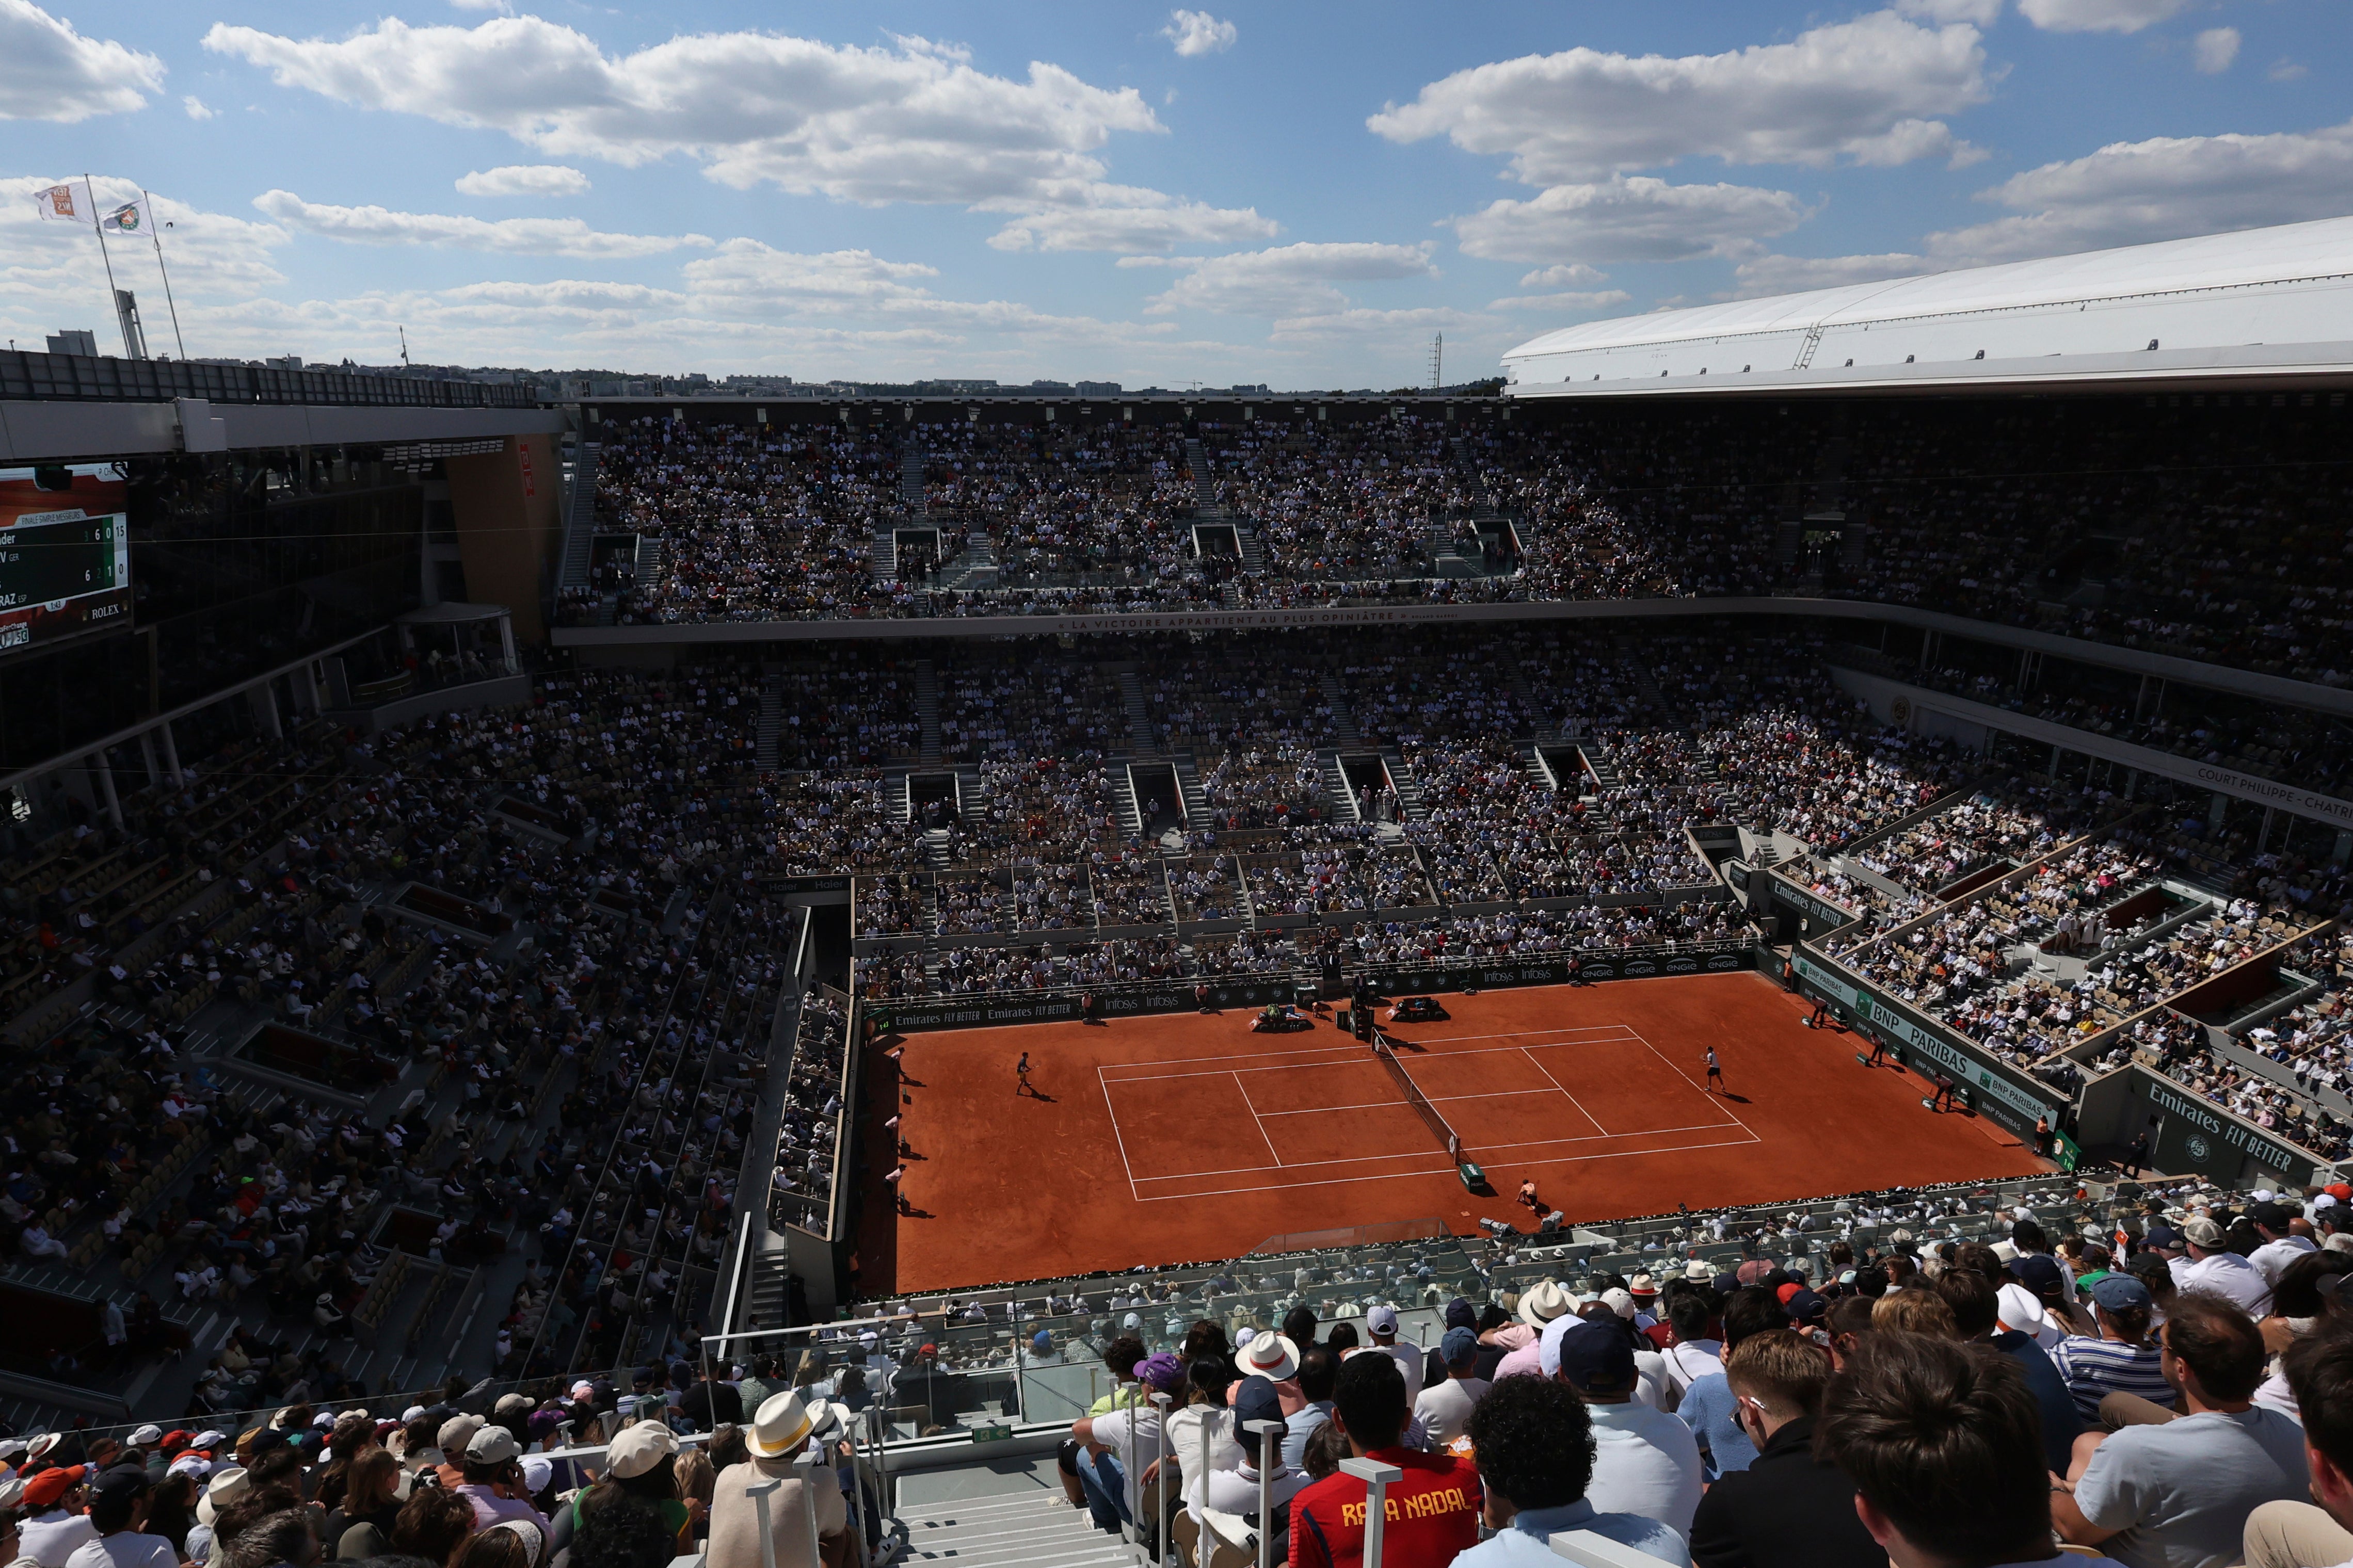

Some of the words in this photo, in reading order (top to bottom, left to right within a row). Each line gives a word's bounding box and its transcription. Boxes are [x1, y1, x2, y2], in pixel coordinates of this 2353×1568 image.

[22, 516, 38, 525] FINALE
[39, 514, 55, 523] SIMPLE
[56, 511, 81, 521] MESSIEURS
[94, 529, 101, 540] 6
[106, 527, 111, 539] 0
[116, 525, 124, 537] 15
[9, 553, 19, 561] GER
[85, 570, 90, 581] 6
[96, 568, 102, 579] 2
[107, 565, 111, 577] 1
[119, 563, 123, 574] 0
[18, 594, 27, 603] ESP
[51, 601, 61, 610] 1:43
[92, 603, 120, 619] ROLEX
[1072, 621, 1087, 629] LA
[1095, 619, 1161, 628] VICTOIRE
[1169, 616, 1253, 626] APPARTIENT
[1260, 615, 1276, 624] AU
[1284, 613, 1315, 623] PLUS
[1322, 610, 1394, 622] OPINIÂTRE
[2198, 768, 2237, 786] COURT
[2239, 779, 2295, 802] PHILIPPE
[769, 881, 797, 891] Haier
[815, 879, 843, 889] Haier
[1774, 880, 1808, 910] Emirates
[1811, 900, 1820, 914] FLY
[1821, 906, 1842, 927] BETTER
[1484, 972, 1514, 983] Infosys
[1522, 967, 1551, 979] Infosys
[1808, 967, 1819, 978] BNP
[1820, 974, 1842, 993] PARIBAS
[1105, 998, 1138, 1011] Infosys
[1146, 995, 1179, 1008] Infosys
[895, 1014, 940, 1026] Emirates
[945, 1012, 955, 1022] FLY
[957, 1011, 980, 1022] BETTER
[988, 1007, 1032, 1020] Emirates
[1035, 1006, 1047, 1016] FLY
[1048, 1004, 1071, 1014] BETTER
[879, 1021, 889, 1030] 1:43
[1856, 1022, 1867, 1031] BNP
[1874, 1005, 1899, 1030] BNP
[1911, 1027, 1967, 1074] PARIBAS
[1915, 1059, 1927, 1070] BNP
[1992, 1080, 2008, 1094] BNP
[2009, 1090, 2042, 1116] PARIBAS
[1981, 1101, 1994, 1116] BNP
[1995, 1109, 2021, 1131] PARIBAS
[2149, 1082, 2220, 1134] Emirates
[2224, 1124, 2247, 1147] FLY
[2247, 1138, 2292, 1172] BETTER
[1342, 1498, 1401, 1528] RAA
[1404, 1487, 1472, 1519] NADAL
